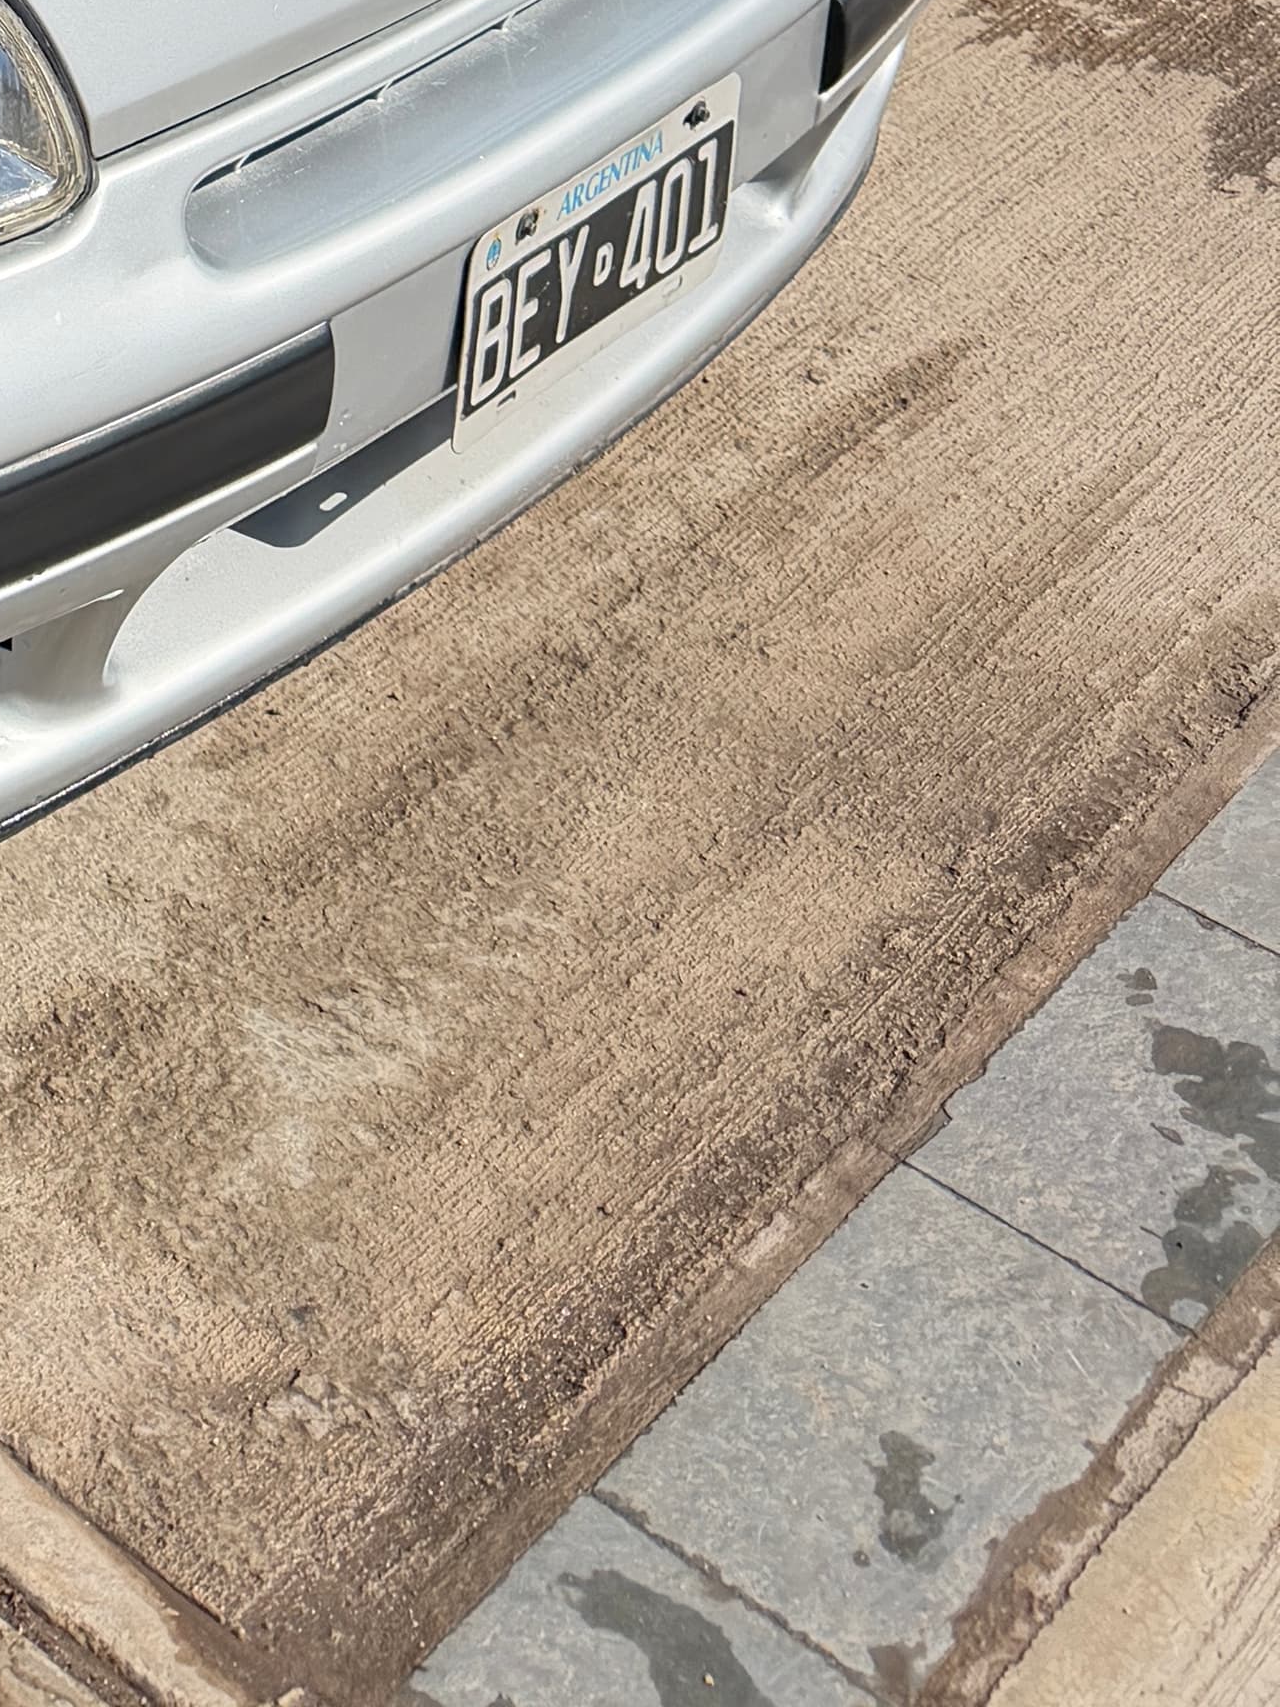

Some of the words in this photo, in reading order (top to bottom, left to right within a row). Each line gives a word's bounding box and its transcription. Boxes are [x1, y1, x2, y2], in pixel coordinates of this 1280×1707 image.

[556, 130, 664, 220] ARGENTINA
[470, 225, 590, 406] BEY
[619, 137, 718, 289] 401
